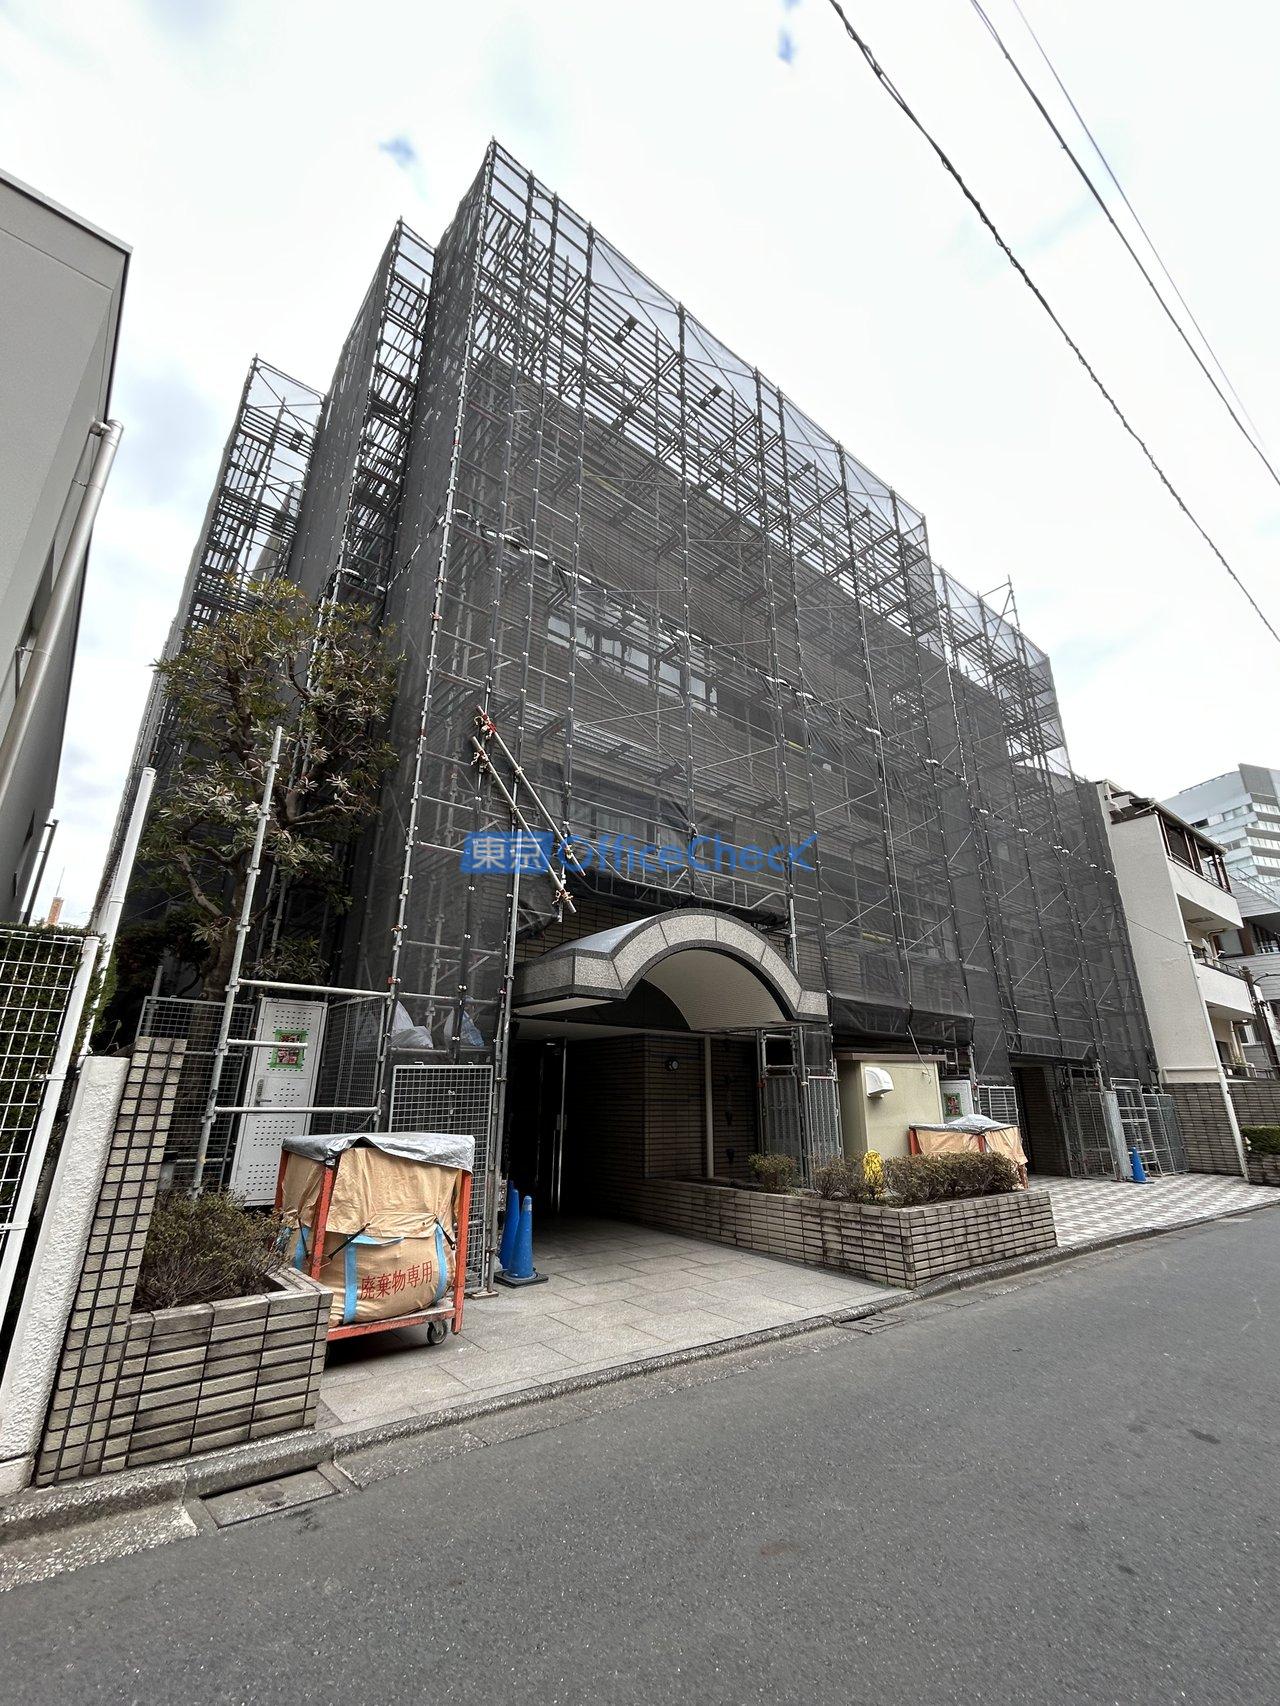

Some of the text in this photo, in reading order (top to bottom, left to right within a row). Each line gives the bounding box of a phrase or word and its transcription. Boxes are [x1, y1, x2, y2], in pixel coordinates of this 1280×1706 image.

[359, 1260, 433, 1301] 廃棄物専用
